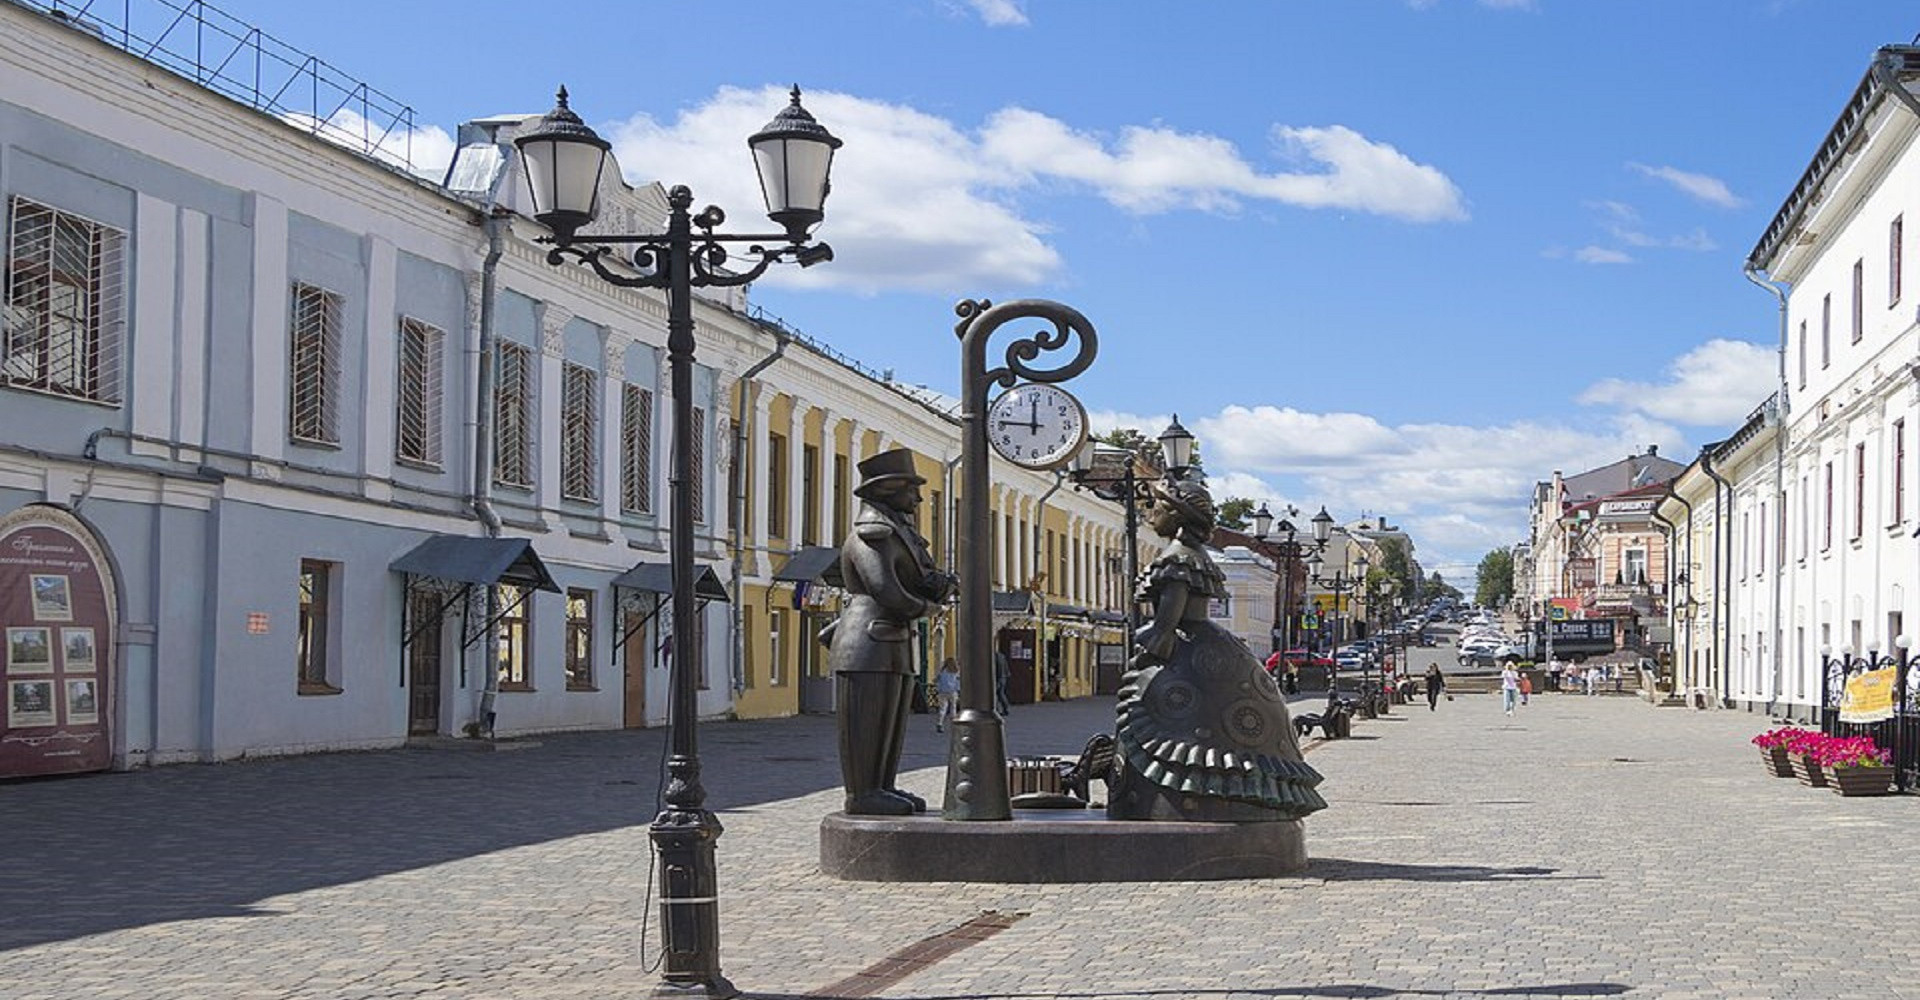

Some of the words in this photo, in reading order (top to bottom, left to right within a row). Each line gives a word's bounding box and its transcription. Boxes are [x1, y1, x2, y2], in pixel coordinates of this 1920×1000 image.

[1028, 392, 1040, 402] 12
[1047, 395, 1053, 406] 1
[1058, 406, 1066, 416] 2
[1064, 420, 1072, 430] 3
[1002, 434, 1010, 445] 8
[1060, 434, 1066, 444] 4
[1016, 445, 1022, 455] 7
[1032, 449, 1038, 459] 6
[1048, 445, 1055, 454] 5
